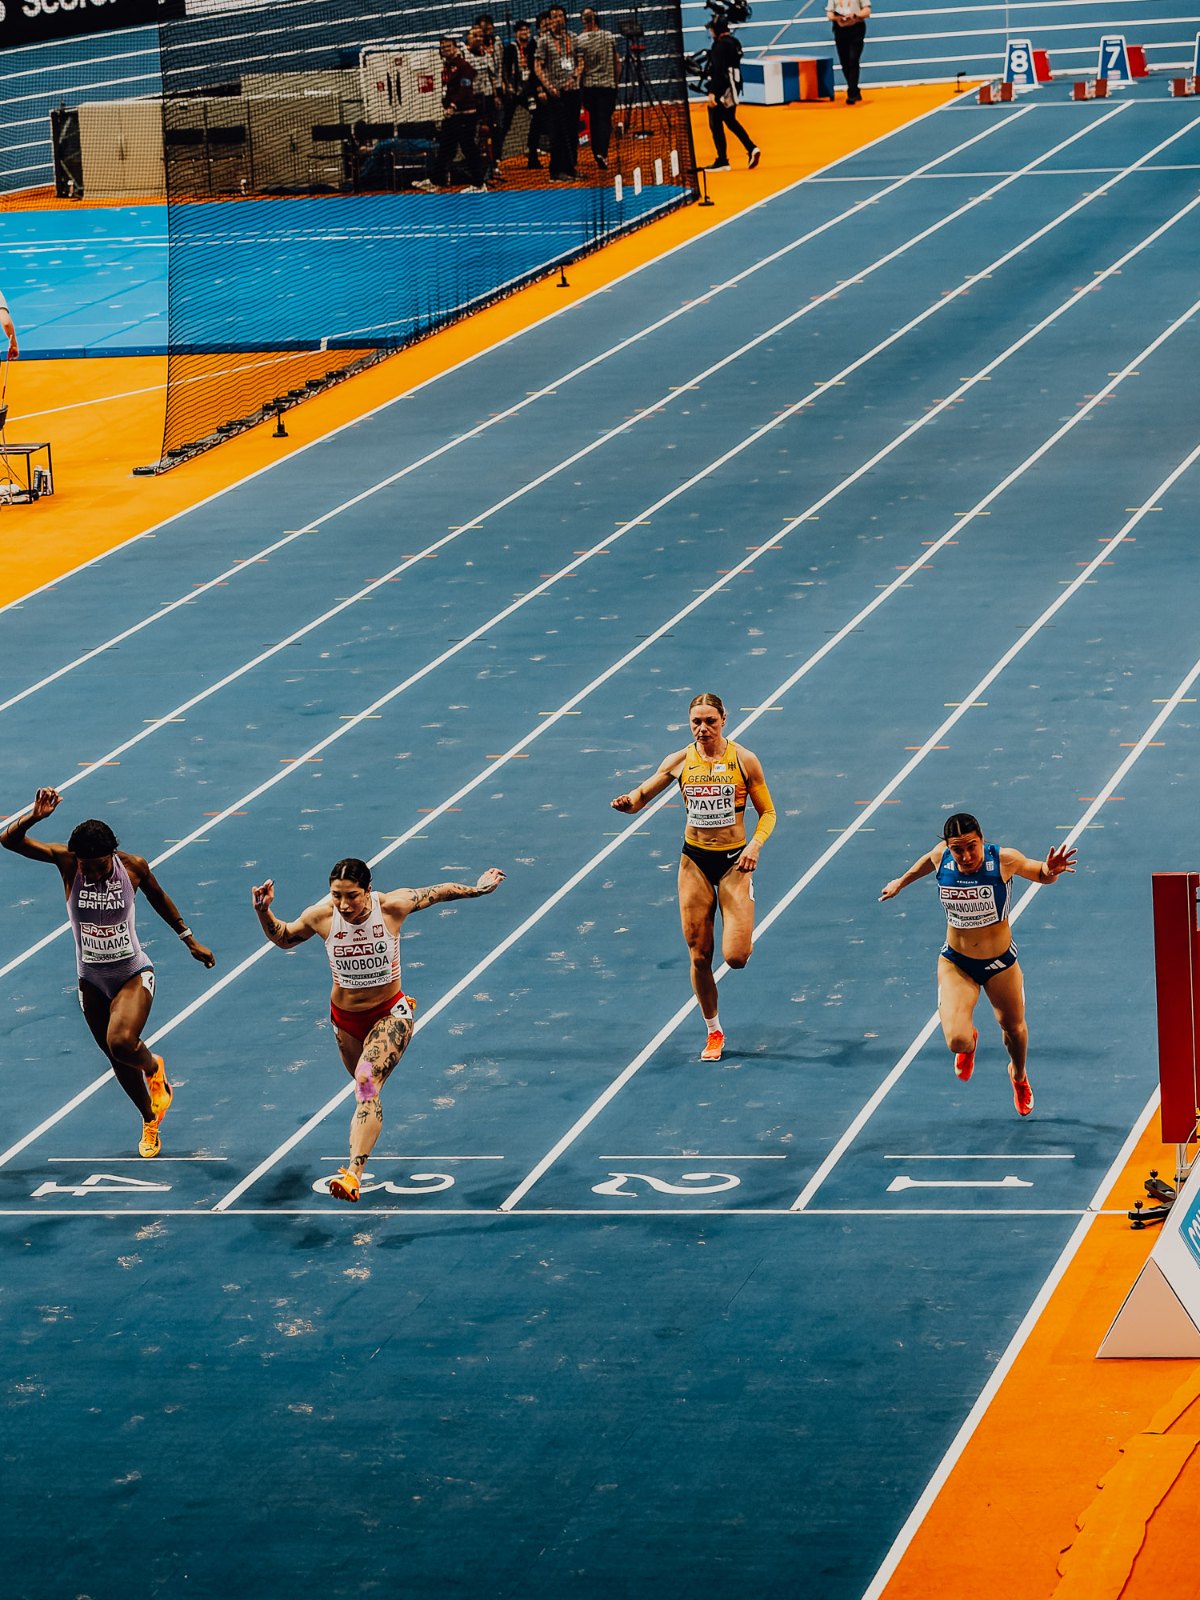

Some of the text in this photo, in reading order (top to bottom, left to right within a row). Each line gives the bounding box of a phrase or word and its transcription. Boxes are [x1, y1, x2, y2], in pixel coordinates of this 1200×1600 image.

[1010, 50, 1029, 73] 8
[1105, 45, 1122, 69] 7
[688, 775, 734, 783] GERMANY
[686, 786, 721, 796] SPAR
[689, 798, 732, 811] MAYER
[79, 890, 123, 901] GREAT
[941, 889, 978, 900] SPAR
[78, 900, 125, 910] BRITAIN
[82, 924, 116, 937] SPAR
[82, 934, 130, 951] WILLIAMS
[334, 944, 374, 956] SPAR
[336, 955, 390, 971] SWOBODA
[30, 1174, 173, 1198] 4
[312, 1172, 456, 1196] 3
[592, 1172, 741, 1198] 2
[887, 1175, 1034, 1192] 1
